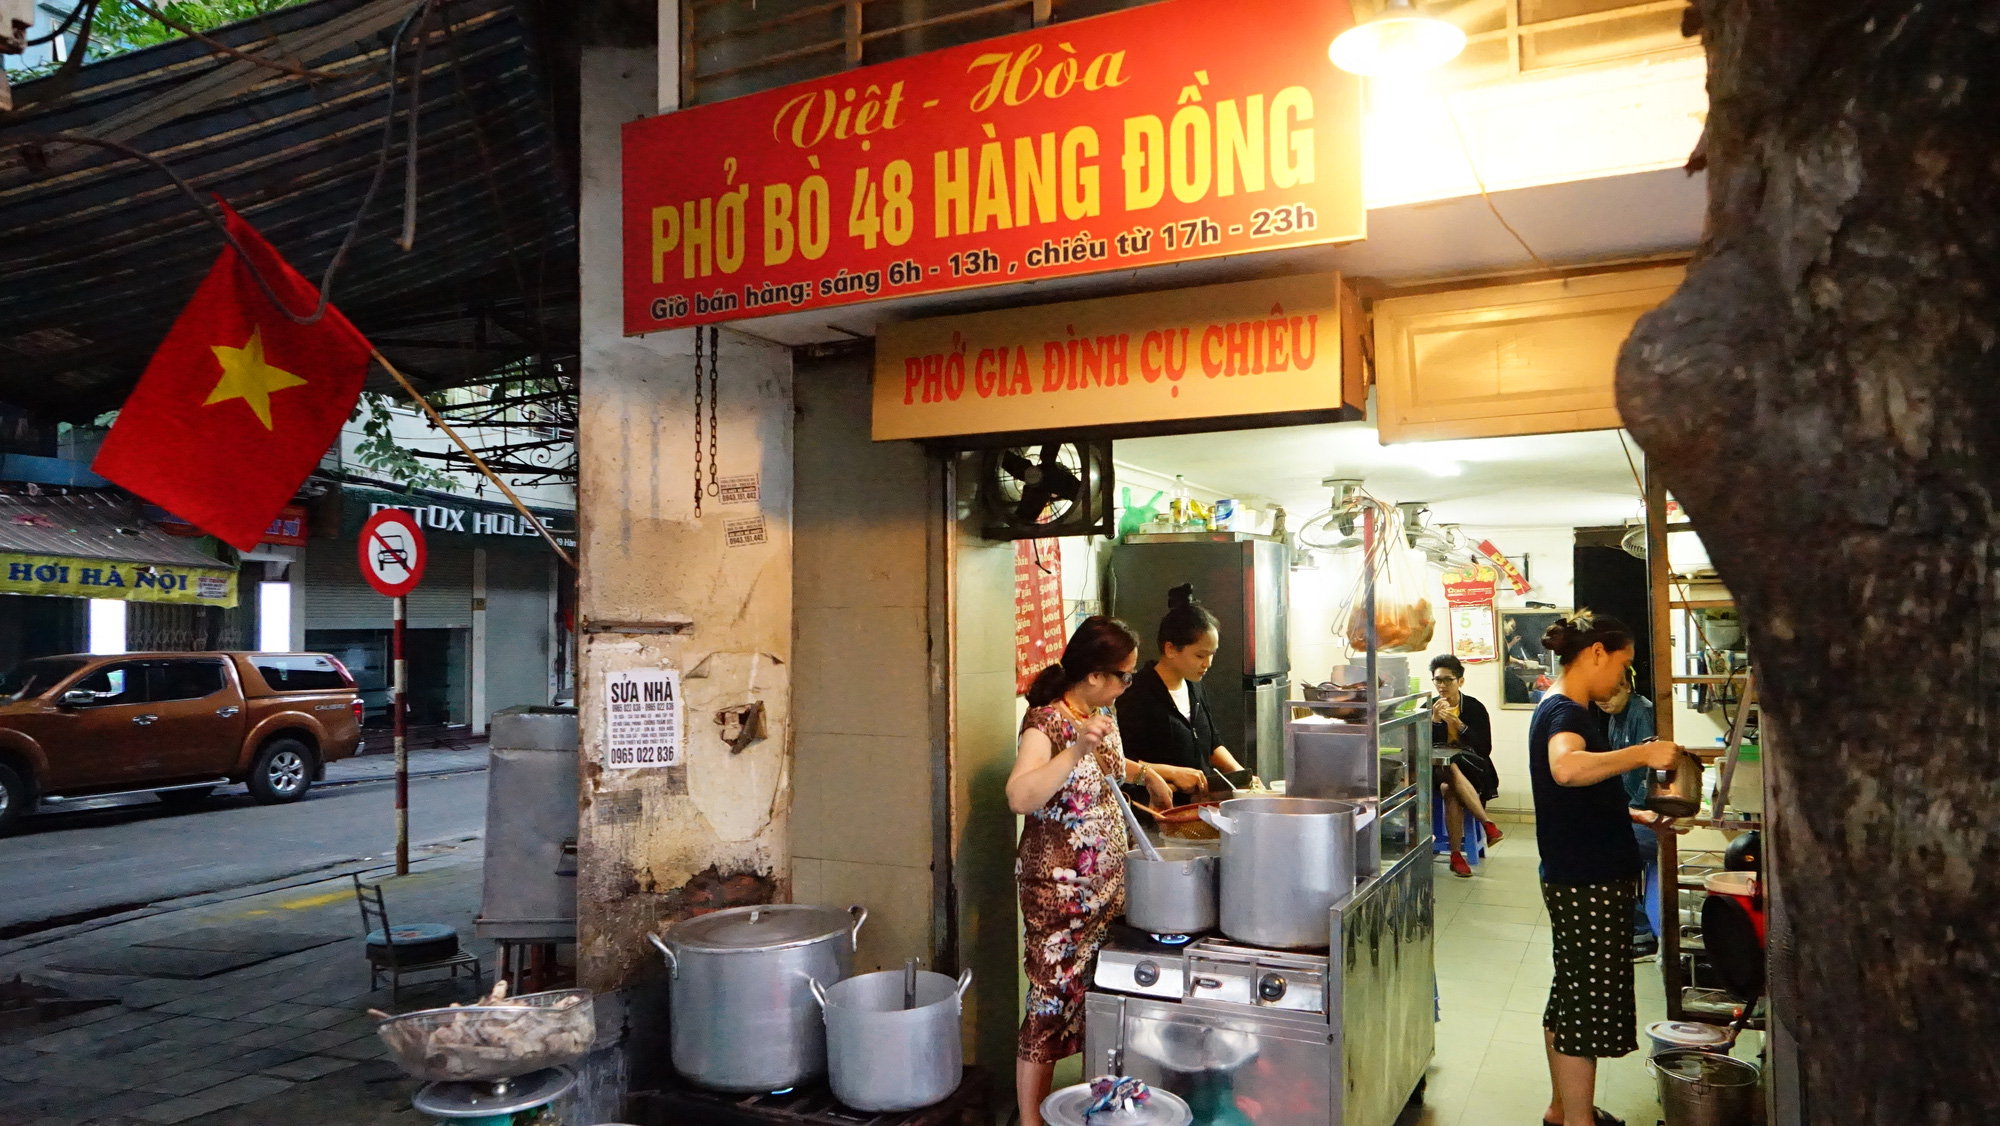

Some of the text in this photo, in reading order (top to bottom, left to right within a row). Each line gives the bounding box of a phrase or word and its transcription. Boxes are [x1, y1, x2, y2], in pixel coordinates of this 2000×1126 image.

[773, 80, 905, 151] Việt
[967, 42, 1132, 112] Hòa
[652, 70, 1315, 284] PHỞ BÒ 48 HÀNG ĐỒNG
[650, 297, 689, 321] Giờ
[695, 288, 738, 315] bán
[745, 281, 812, 306] hàng:
[821, 268, 881, 295] sáng
[889, 261, 922, 285] 6h
[948, 249, 1000, 278] 13h
[1026, 231, 1106, 267] chiều
[1116, 228, 1151, 255] từ
[1160, 217, 1220, 250] 17h
[1250, 203, 1316, 236] 23h
[902, 301, 1319, 405] PHỞ GIA ĐÌNH CỤ CHIÊU
[370, 502, 465, 532] TOX
[8, 562, 71, 584] HƠI
[79, 564, 125, 588] HÀ
[134, 568, 188, 595] NỘI
[1460, 612, 1471, 628] 5
[611, 673, 674, 703] SỬA NHÀ
[611, 745, 674, 764] 0965 022 836
